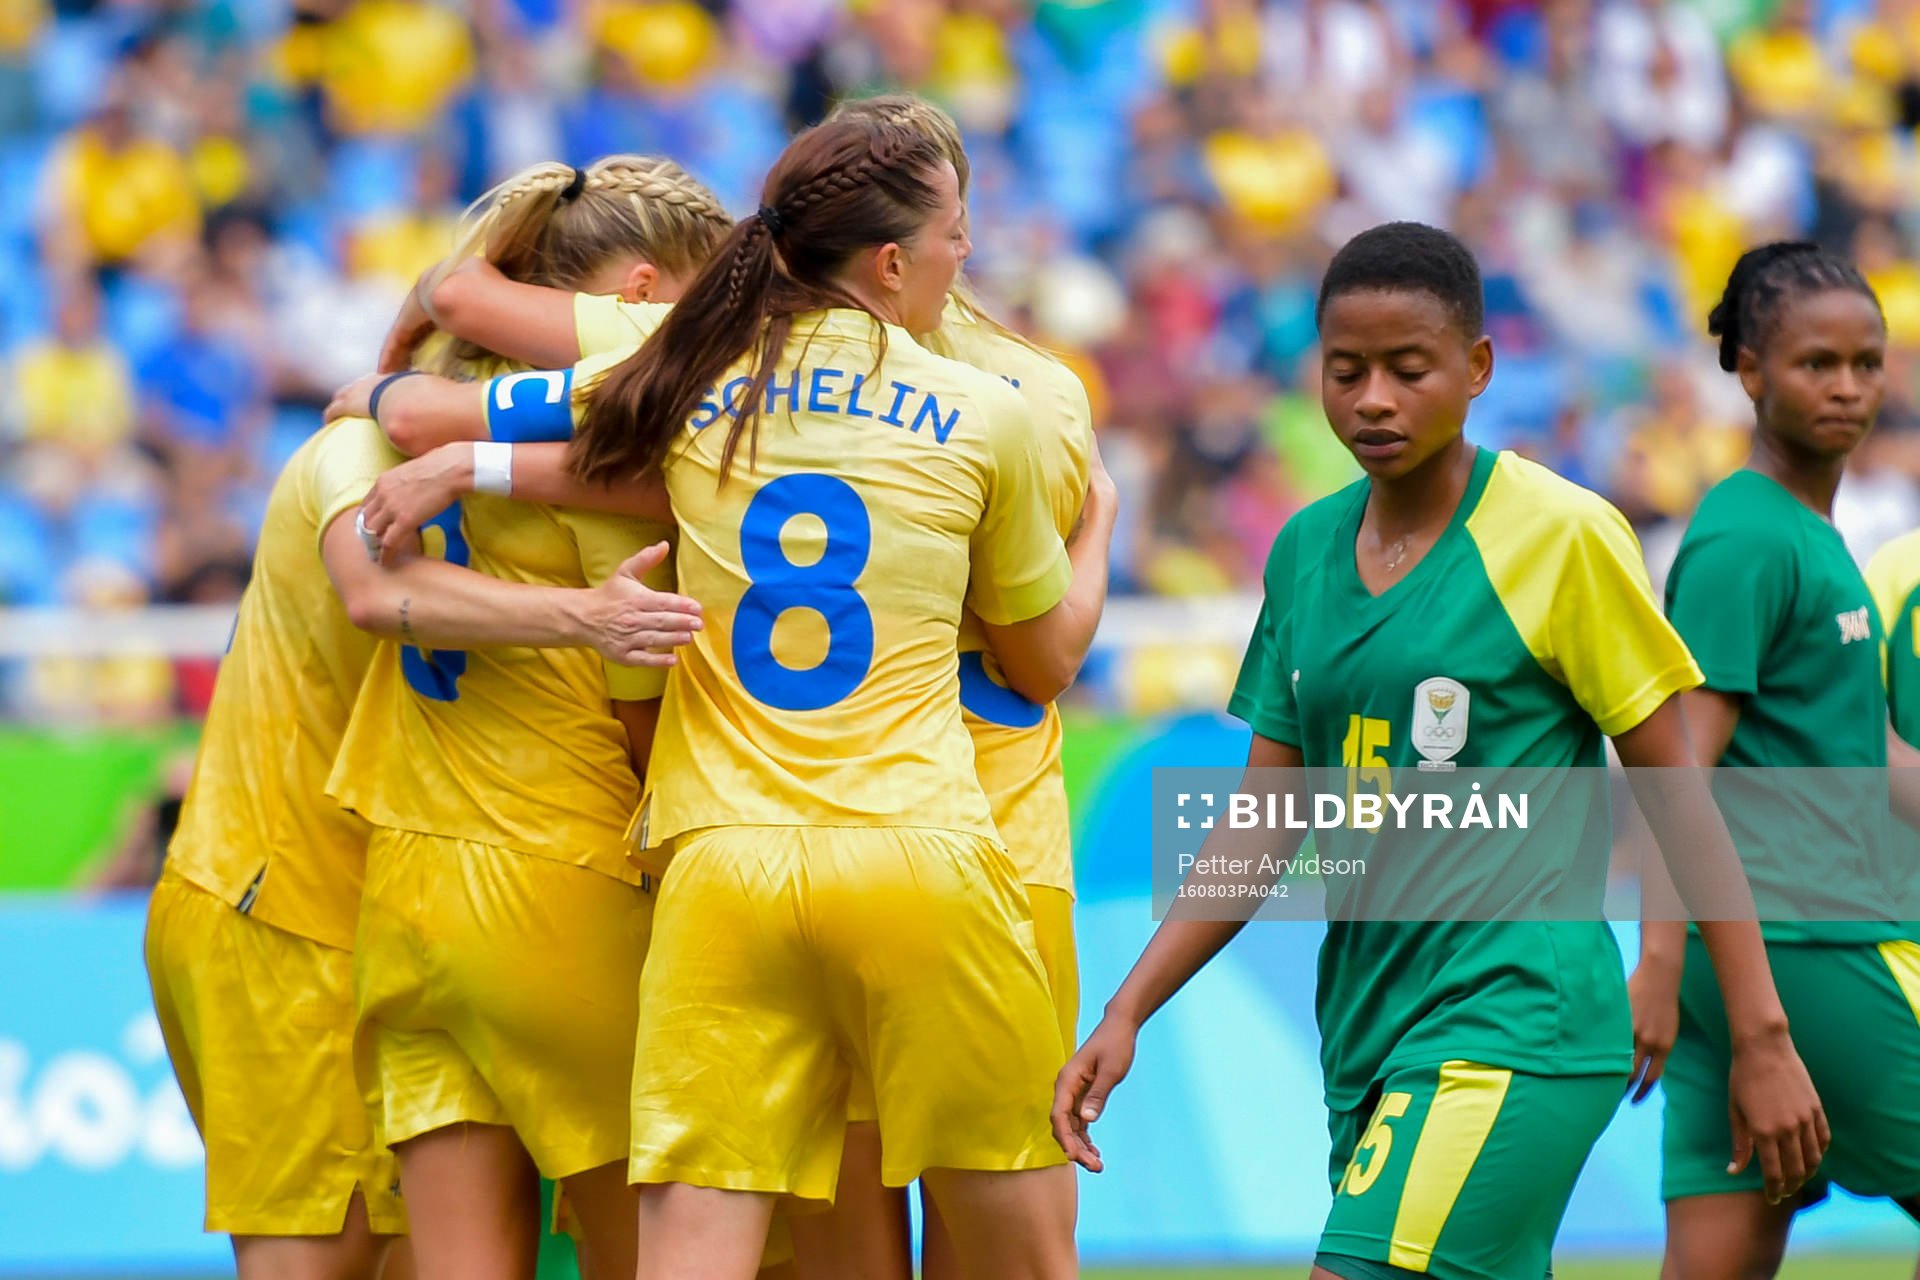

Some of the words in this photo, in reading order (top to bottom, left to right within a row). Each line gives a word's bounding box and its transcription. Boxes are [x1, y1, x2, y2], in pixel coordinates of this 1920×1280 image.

[689, 367, 961, 446] SCHELIN
[731, 473, 874, 711] 8
[1342, 714, 1392, 834] 15
